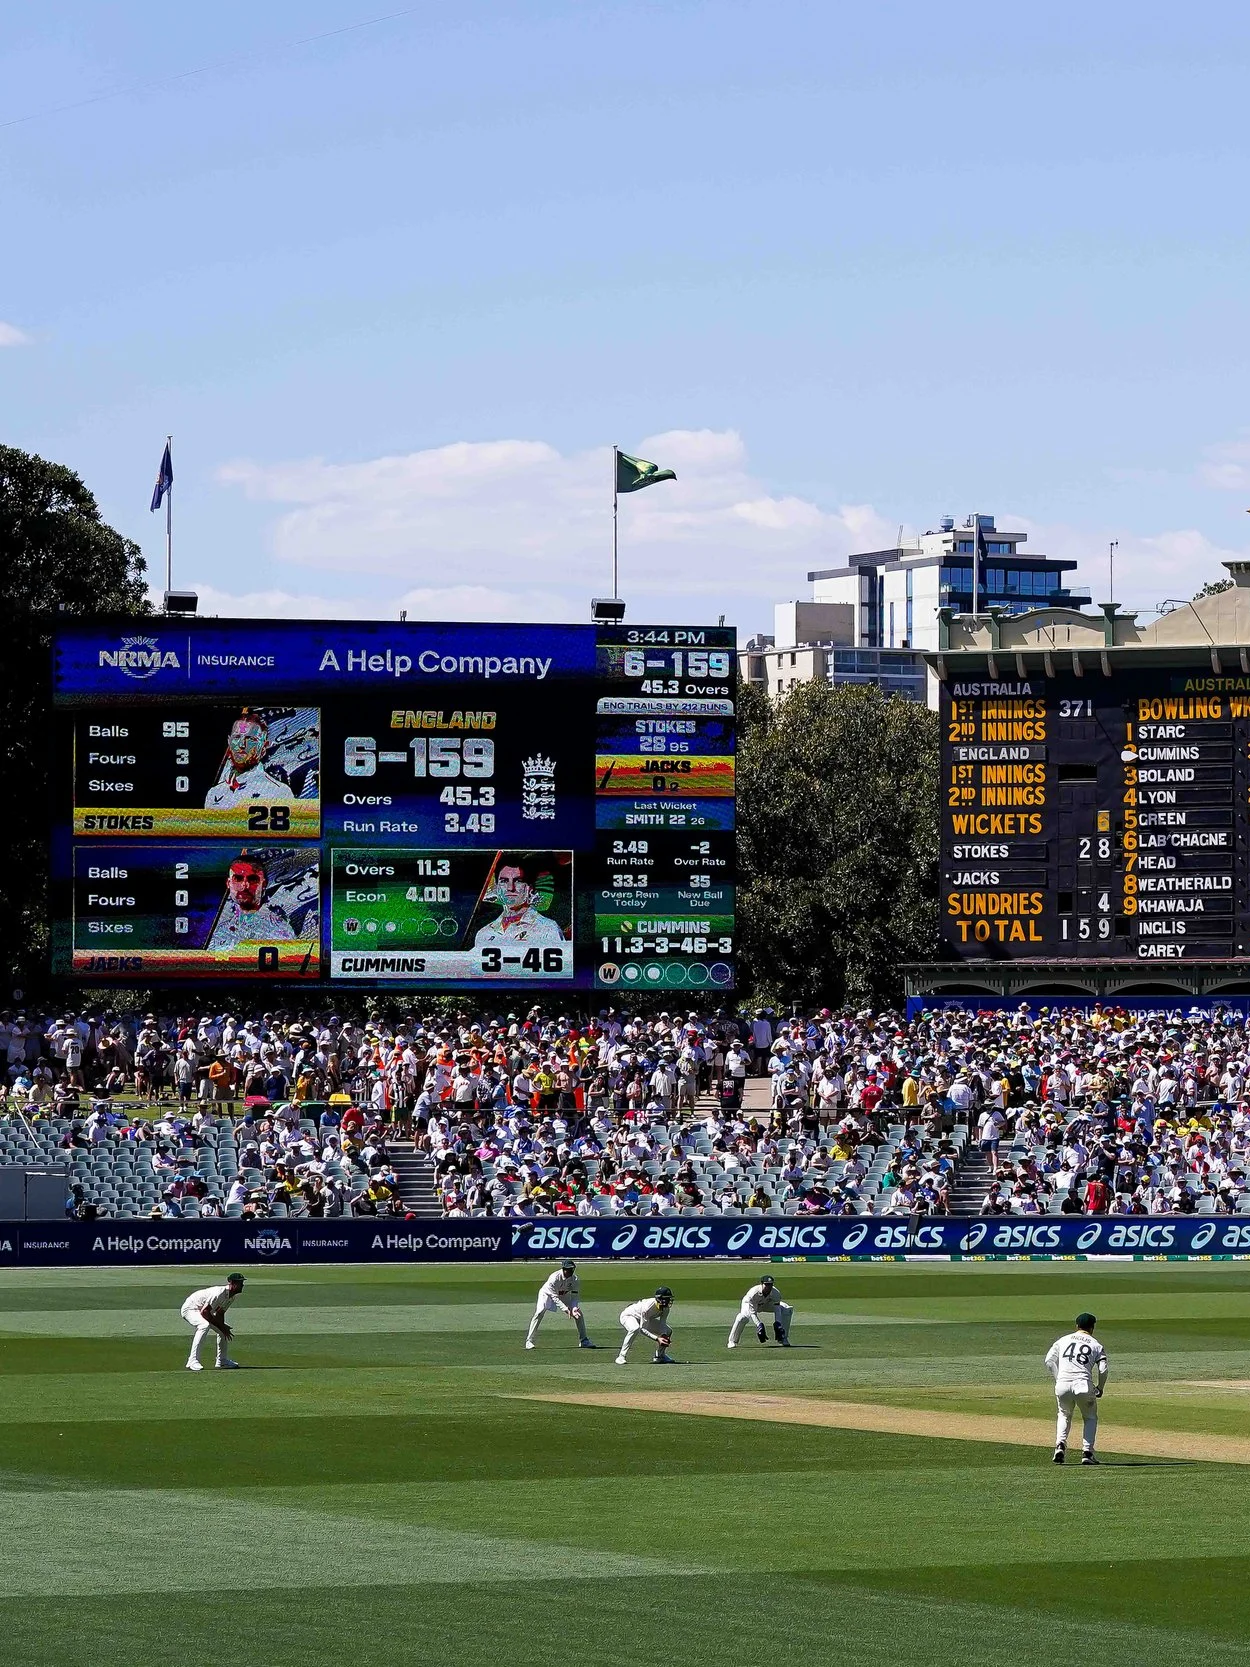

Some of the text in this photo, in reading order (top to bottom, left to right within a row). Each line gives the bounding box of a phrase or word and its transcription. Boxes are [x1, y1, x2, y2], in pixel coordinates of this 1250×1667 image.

[628, 631, 705, 644] 3:44 PM
[99, 651, 274, 668] NRMA INSURANCE
[319, 650, 552, 679] A Help Company
[624, 651, 729, 677] 6-159
[641, 680, 728, 694] 45.3 Overs
[953, 683, 1032, 695] AUSTRALIA
[982, 700, 1046, 720] INNINGS
[1059, 700, 1092, 717] 371
[1139, 696, 1221, 720] BOWLING
[390, 711, 496, 729] ENGLAND
[636, 720, 696, 733] STOKES
[89, 722, 189, 737] Balls 95
[982, 722, 1046, 741] INNINGS
[1139, 726, 1185, 739] STARC
[640, 736, 688, 751] 28 95
[89, 753, 136, 764] Fours
[344, 737, 495, 777] 6-159
[959, 748, 1030, 760] ENGLAND
[1138, 747, 1199, 761] CUMMINS
[640, 760, 691, 773] JACKS
[982, 764, 1046, 783] INNINGS
[1138, 769, 1194, 783] BOLAND
[89, 780, 133, 792] Sixes
[343, 787, 495, 806] Overs 45.3
[982, 786, 1046, 806] INNINGS
[1139, 791, 1176, 804] LYON
[660, 802, 697, 810] Wicket
[84, 806, 290, 830] STOKES 28
[343, 813, 495, 833] Run Rate 3.49
[626, 815, 663, 824] SMITH
[669, 815, 685, 824] 22
[952, 814, 1042, 834] WICKETS
[1139, 812, 1185, 826] GREEN
[613, 841, 648, 853] 3.49
[953, 845, 1009, 858] STOKES
[346, 860, 450, 875] Overs 11.3
[1139, 857, 1176, 869] HEAD
[89, 868, 127, 878] Balls
[953, 872, 999, 885] JACKS
[613, 875, 647, 887] 33.3
[690, 875, 710, 888] 35
[1139, 877, 1232, 891] WEATHERALD
[89, 895, 135, 906] Fours
[346, 887, 450, 902] Econ 4.00
[704, 891, 722, 899] Ball
[614, 900, 646, 908] Today
[948, 892, 1043, 915] SUNDRIES
[1139, 900, 1204, 913] KHAWAJA
[88, 922, 133, 933] Sixes
[638, 921, 710, 933] CUMMINS
[957, 920, 1042, 942] TOTAL
[1139, 922, 1186, 934] INGLIS
[1139, 945, 1185, 958] CAREY
[85, 957, 142, 970] JACKS
[341, 948, 563, 973] CUMMINS 3-46
[24, 1241, 70, 1249] INSURANCE
[93, 1237, 221, 1253] A Help Company
[244, 1238, 291, 1248] NRMA
[371, 1235, 500, 1251] A Help Company
[1063, 1343, 1092, 1364] 48
